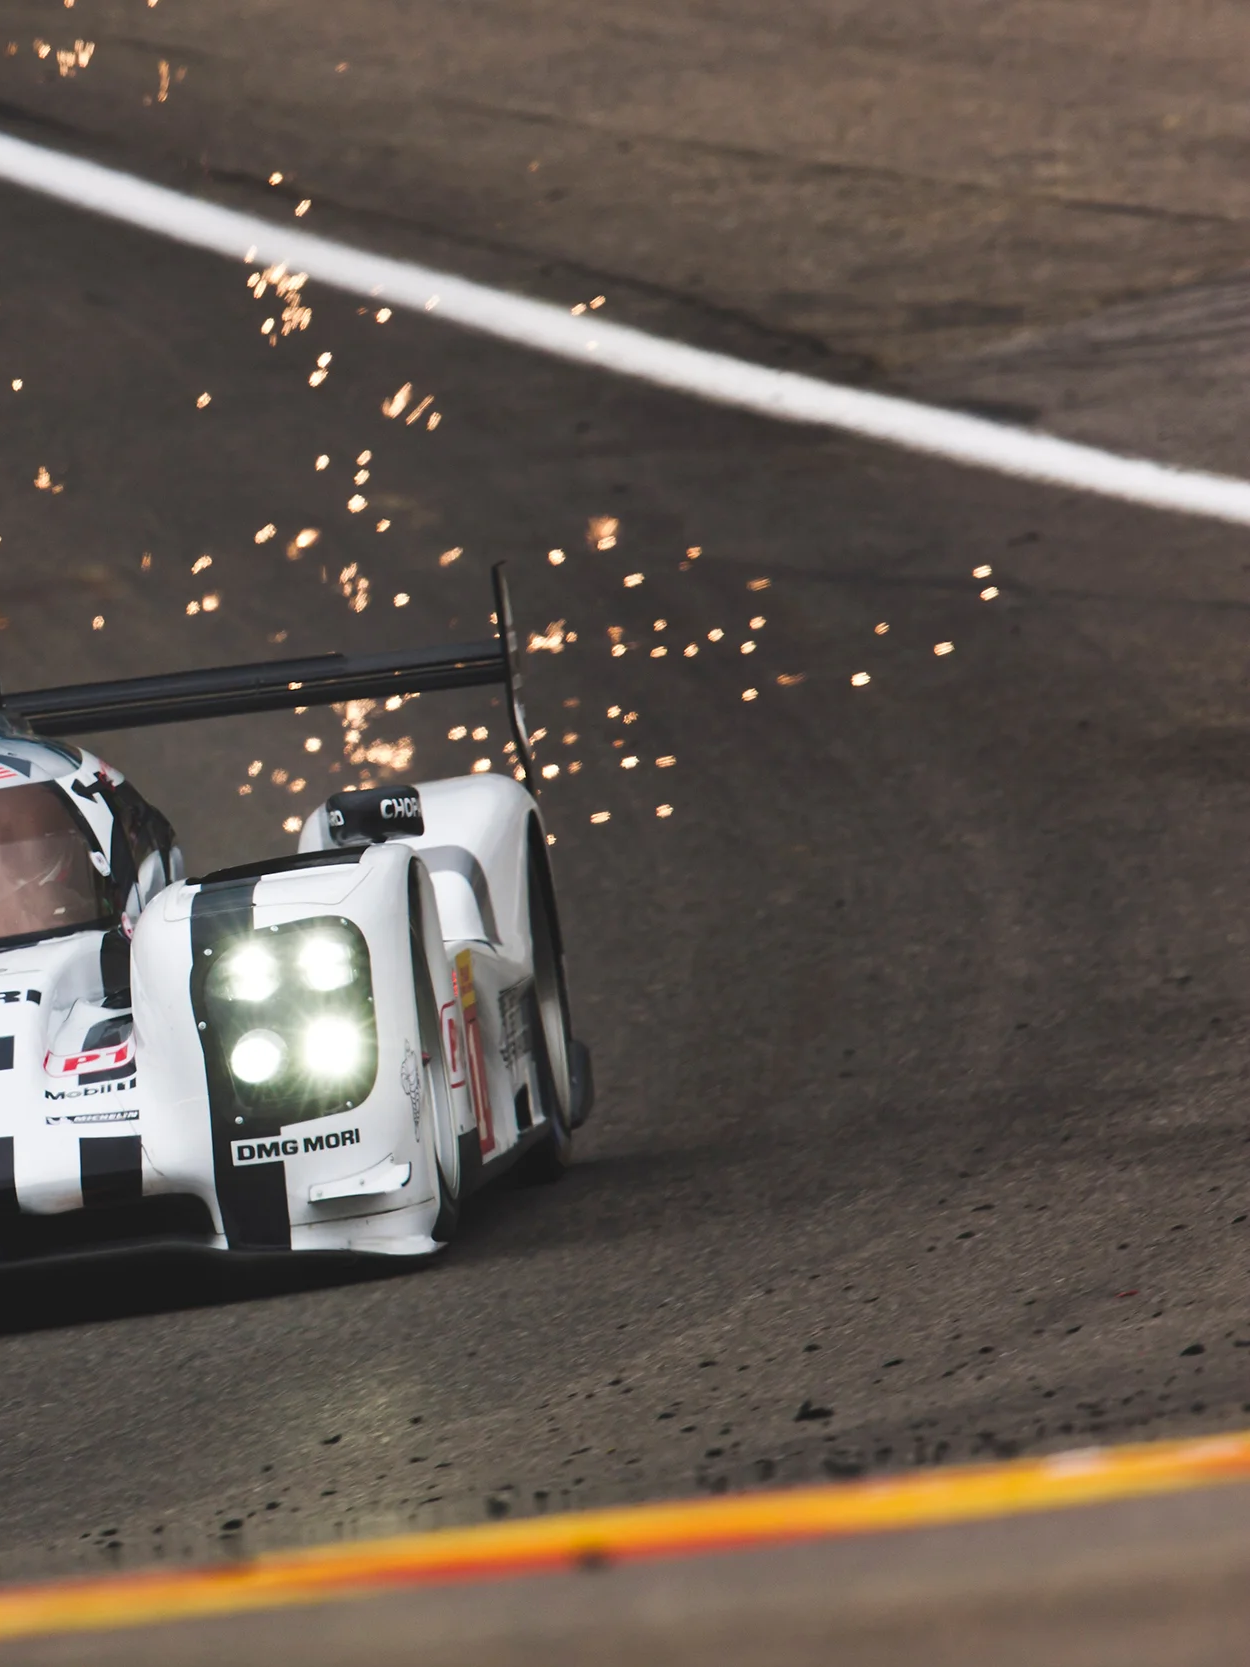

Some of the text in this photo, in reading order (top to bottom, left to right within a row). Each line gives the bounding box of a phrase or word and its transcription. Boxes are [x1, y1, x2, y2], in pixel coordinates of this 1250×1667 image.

[62, 1044, 128, 1072] P1
[45, 1083, 111, 1100] Mobil
[73, 1110, 139, 1123] MICHELIN
[237, 1128, 360, 1161] DMG MORI
